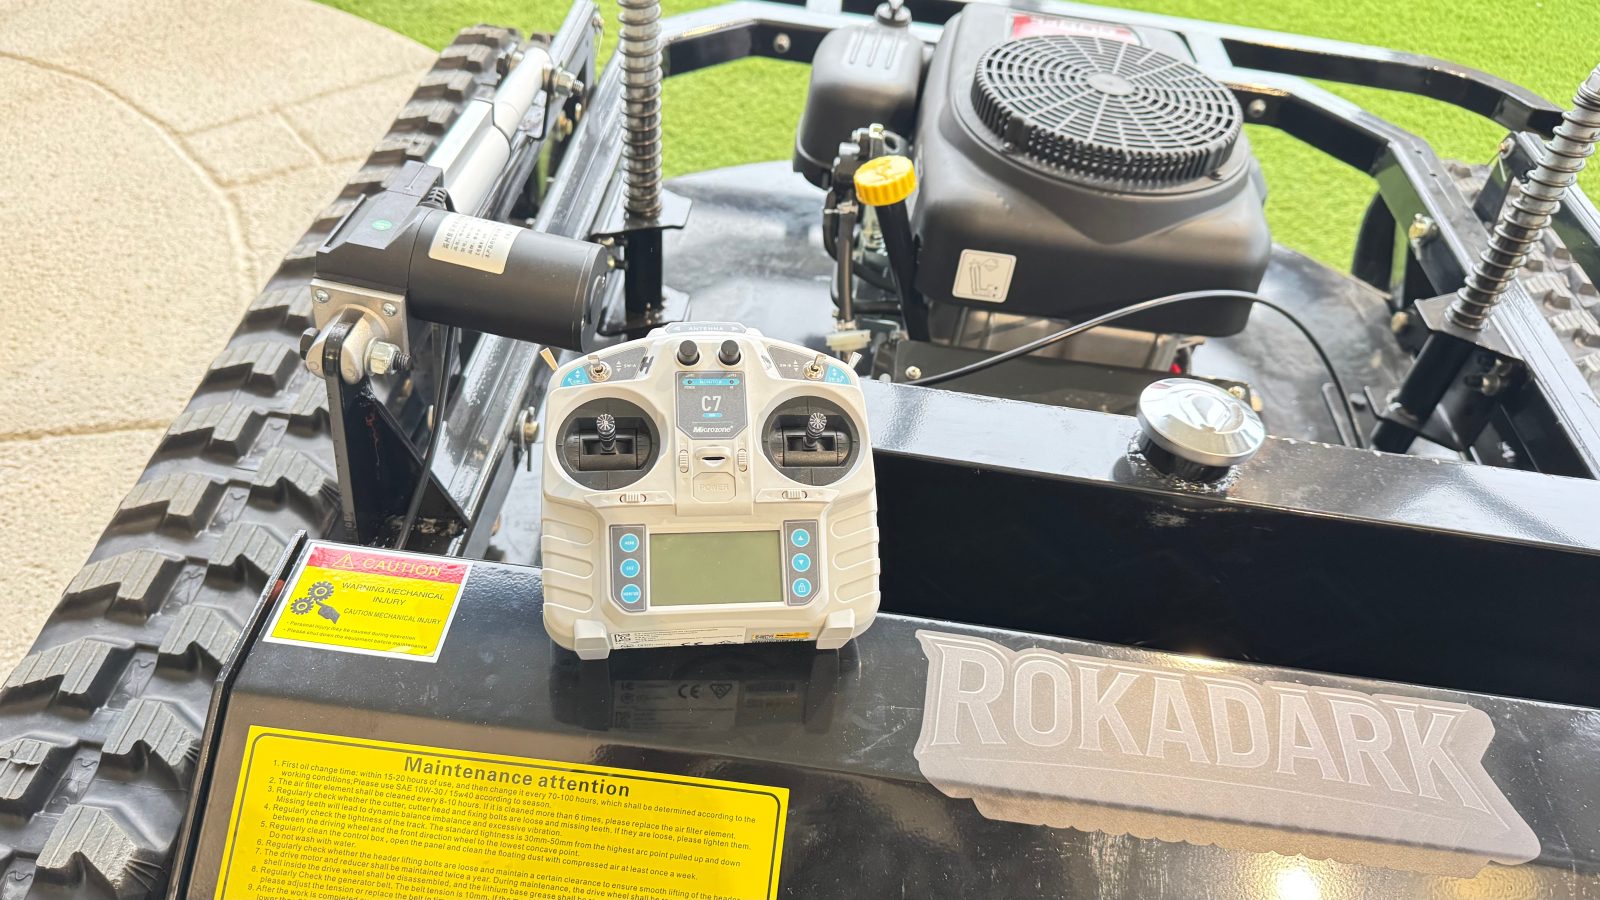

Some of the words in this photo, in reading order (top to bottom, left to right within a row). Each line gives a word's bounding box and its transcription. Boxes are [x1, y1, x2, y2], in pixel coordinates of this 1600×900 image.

[702, 396, 722, 412] C7
[362, 558, 442, 576] CAUTION
[342, 582, 384, 593] WARNING
[386, 588, 445, 600] MECHANICAL
[372, 596, 406, 606] INJURY
[344, 608, 374, 617] CAUTION
[374, 611, 416, 622] MECHANICAL
[417, 616, 442, 625] INJURY
[930, 640, 1490, 814] ROKADARK
[281, 761, 299, 769] First
[310, 764, 339, 775] change
[360, 771, 382, 779] within
[406, 776, 428, 785] hours
[471, 784, 489, 792] then
[489, 786, 518, 796] change
[525, 791, 547, 800] every
[600, 799, 623, 808] which
[624, 802, 642, 810] shall
[654, 805, 697, 816] determined
[697, 811, 734, 823] according
[282, 771, 311, 781] working
[396, 783, 413, 792] SAE
[474, 794, 512, 805] according
[404, 756, 532, 786] Maintenance
[538, 773, 630, 797] attention
[276, 795, 306, 807] Missing
[306, 799, 326, 808] teeth
[341, 803, 359, 812] lead
[368, 806, 400, 817] dynamic
[401, 811, 432, 821] balance
[432, 815, 472, 826] imbalance
[488, 823, 526, 832] excessive
[276, 787, 313, 799] Regularly
[313, 792, 337, 801] check
[337, 795, 369, 804] whether
[431, 806, 451, 814] head
[467, 810, 488, 820] fixing
[488, 812, 508, 821] bolts
[522, 816, 544, 825] loose
[560, 822, 590, 832] missing
[621, 828, 638, 838] they
[676, 835, 702, 844] please
[703, 838, 729, 847] tighten
[278, 778, 293, 786] The
[305, 781, 323, 790] filter
[323, 784, 354, 794] element
[355, 788, 374, 796] shall
[385, 792, 416, 801] cleaned
[416, 796, 439, 805] every
[504, 806, 535, 815] cleaned
[556, 812, 573, 820] than
[605, 817, 631, 827] please
[631, 821, 660, 830] replace
[686, 827, 703, 835] filter
[269, 831, 281, 839] Do
[272, 813, 305, 823] between
[320, 819, 346, 830] driving
[347, 823, 370, 832] wheel
[400, 828, 418, 837] front
[419, 831, 453, 841] direction
[500, 841, 525, 850] lowest
[526, 846, 558, 854] concave
[255, 885, 276, 893] After
